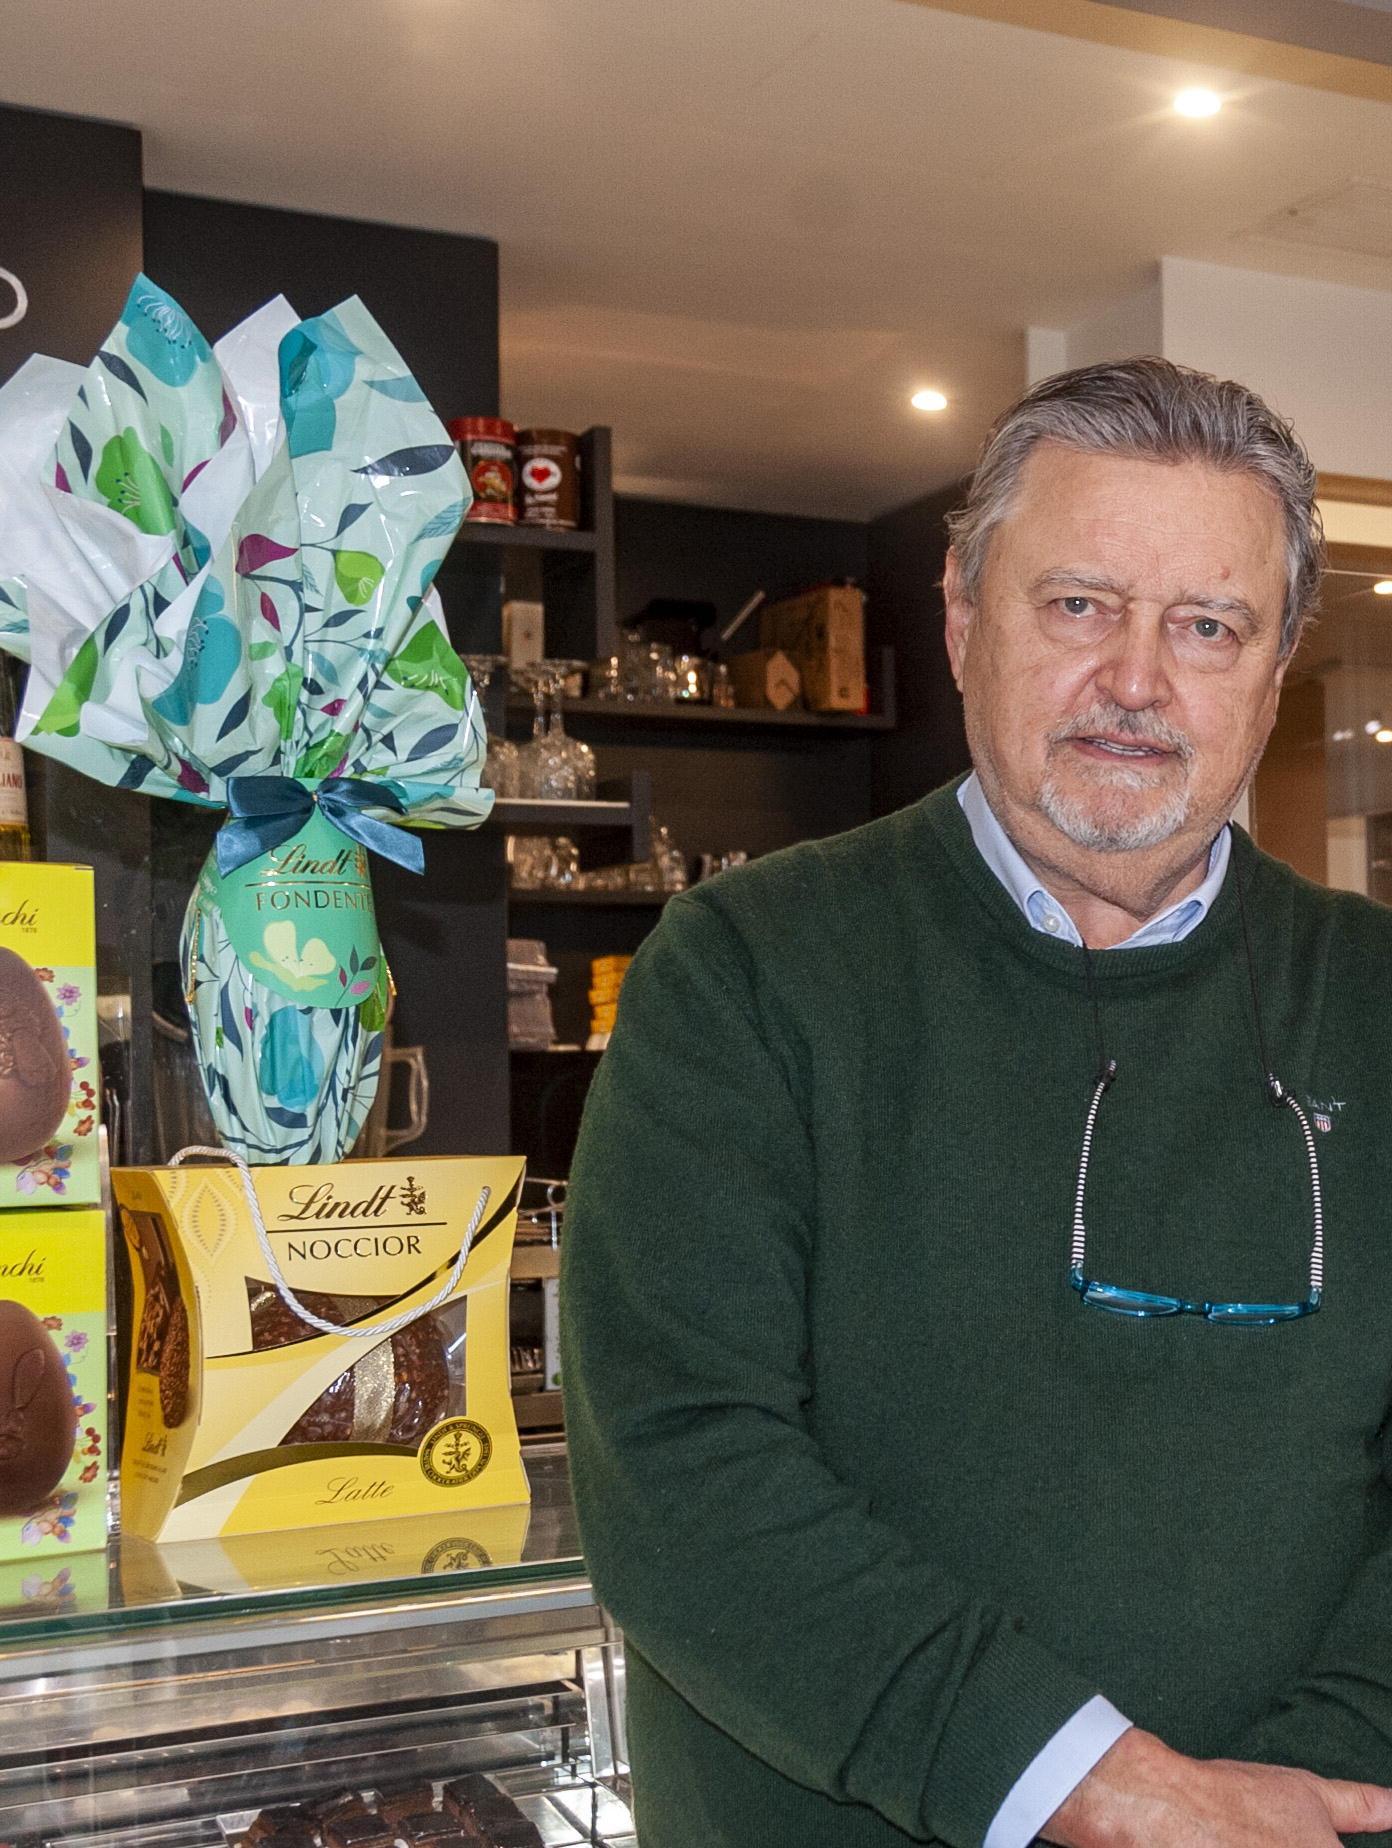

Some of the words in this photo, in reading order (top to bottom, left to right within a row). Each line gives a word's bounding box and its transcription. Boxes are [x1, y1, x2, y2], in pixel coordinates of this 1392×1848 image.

[260, 843, 353, 876] Lindt
[277, 1182, 397, 1222] Lindt
[288, 1235, 422, 1261] NOCCIOR
[315, 1476, 395, 1505] Latte
